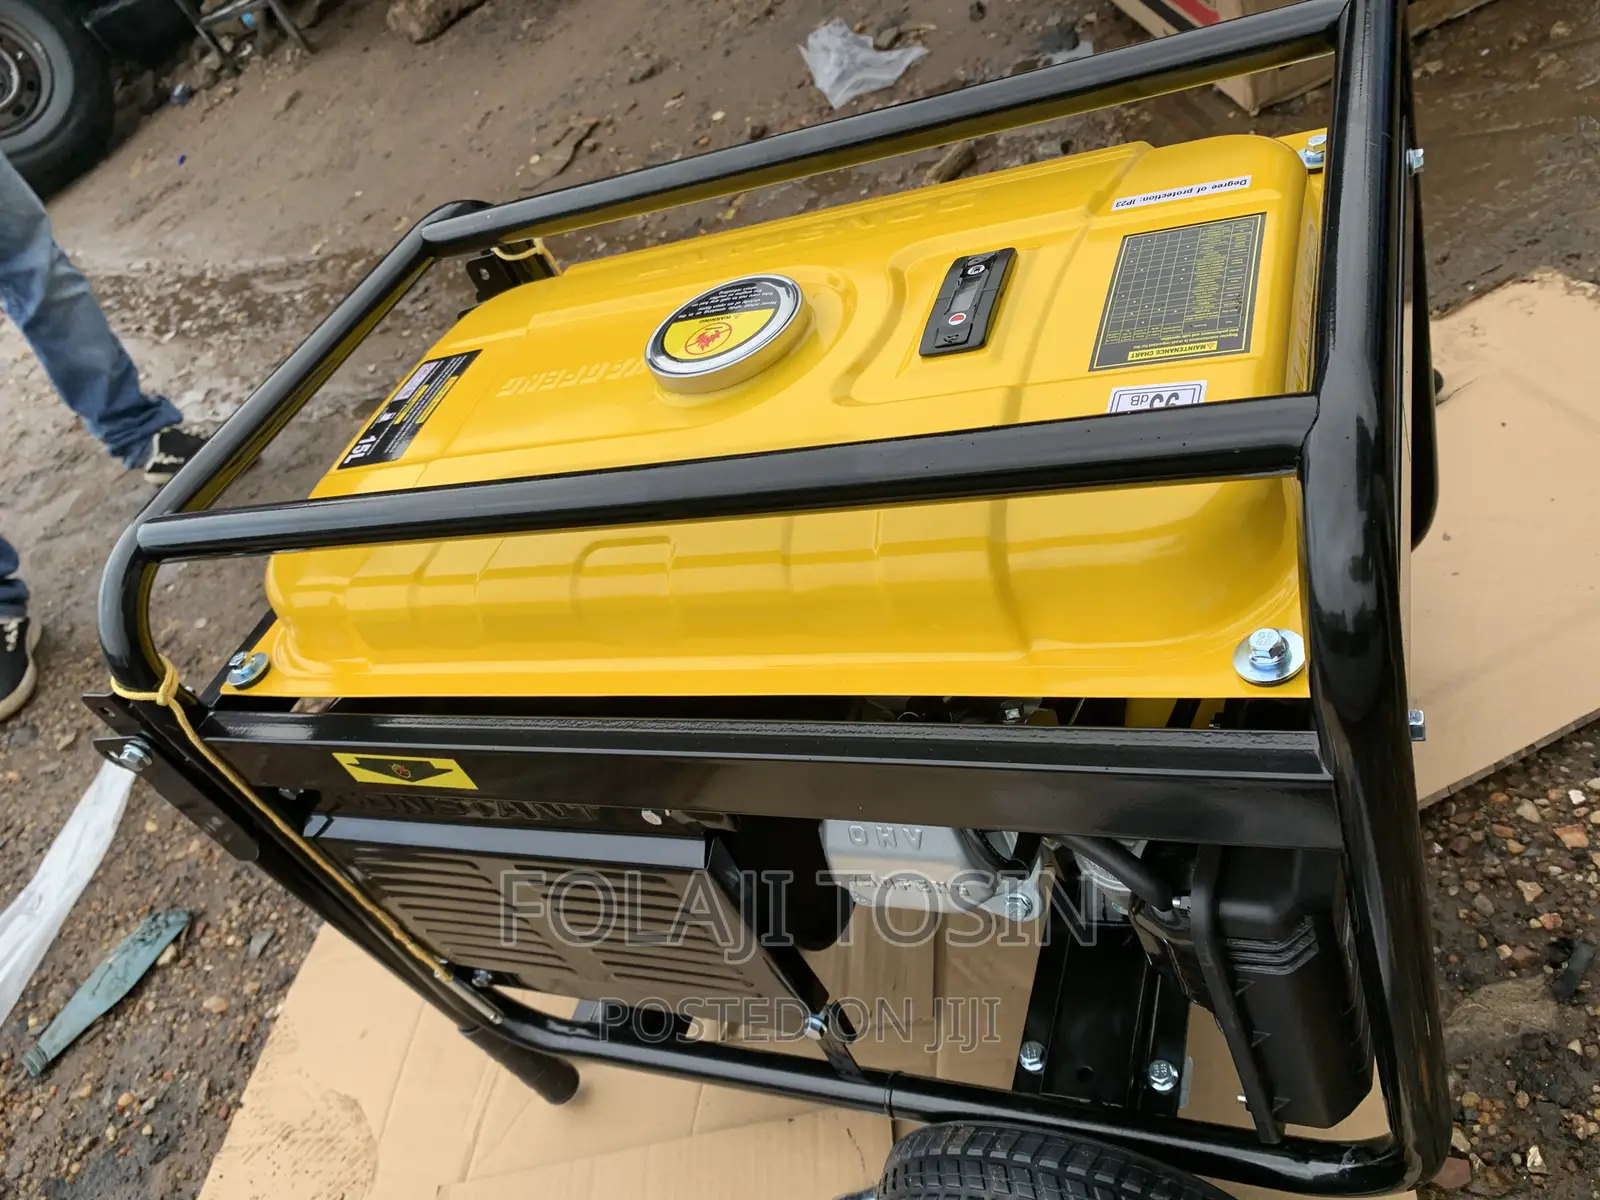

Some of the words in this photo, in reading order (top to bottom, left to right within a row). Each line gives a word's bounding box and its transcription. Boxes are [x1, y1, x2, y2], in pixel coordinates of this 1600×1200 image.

[1196, 184, 1208, 195] of
[1211, 178, 1248, 190] Degree
[1139, 186, 1193, 203] protection:
[1115, 197, 1136, 208] IP23
[1130, 350, 1154, 358] CHART
[1155, 344, 1206, 355] MAINTENANCE
[1131, 394, 1149, 406] dB
[343, 435, 377, 464] 15L
[847, 823, 923, 850] OHV
